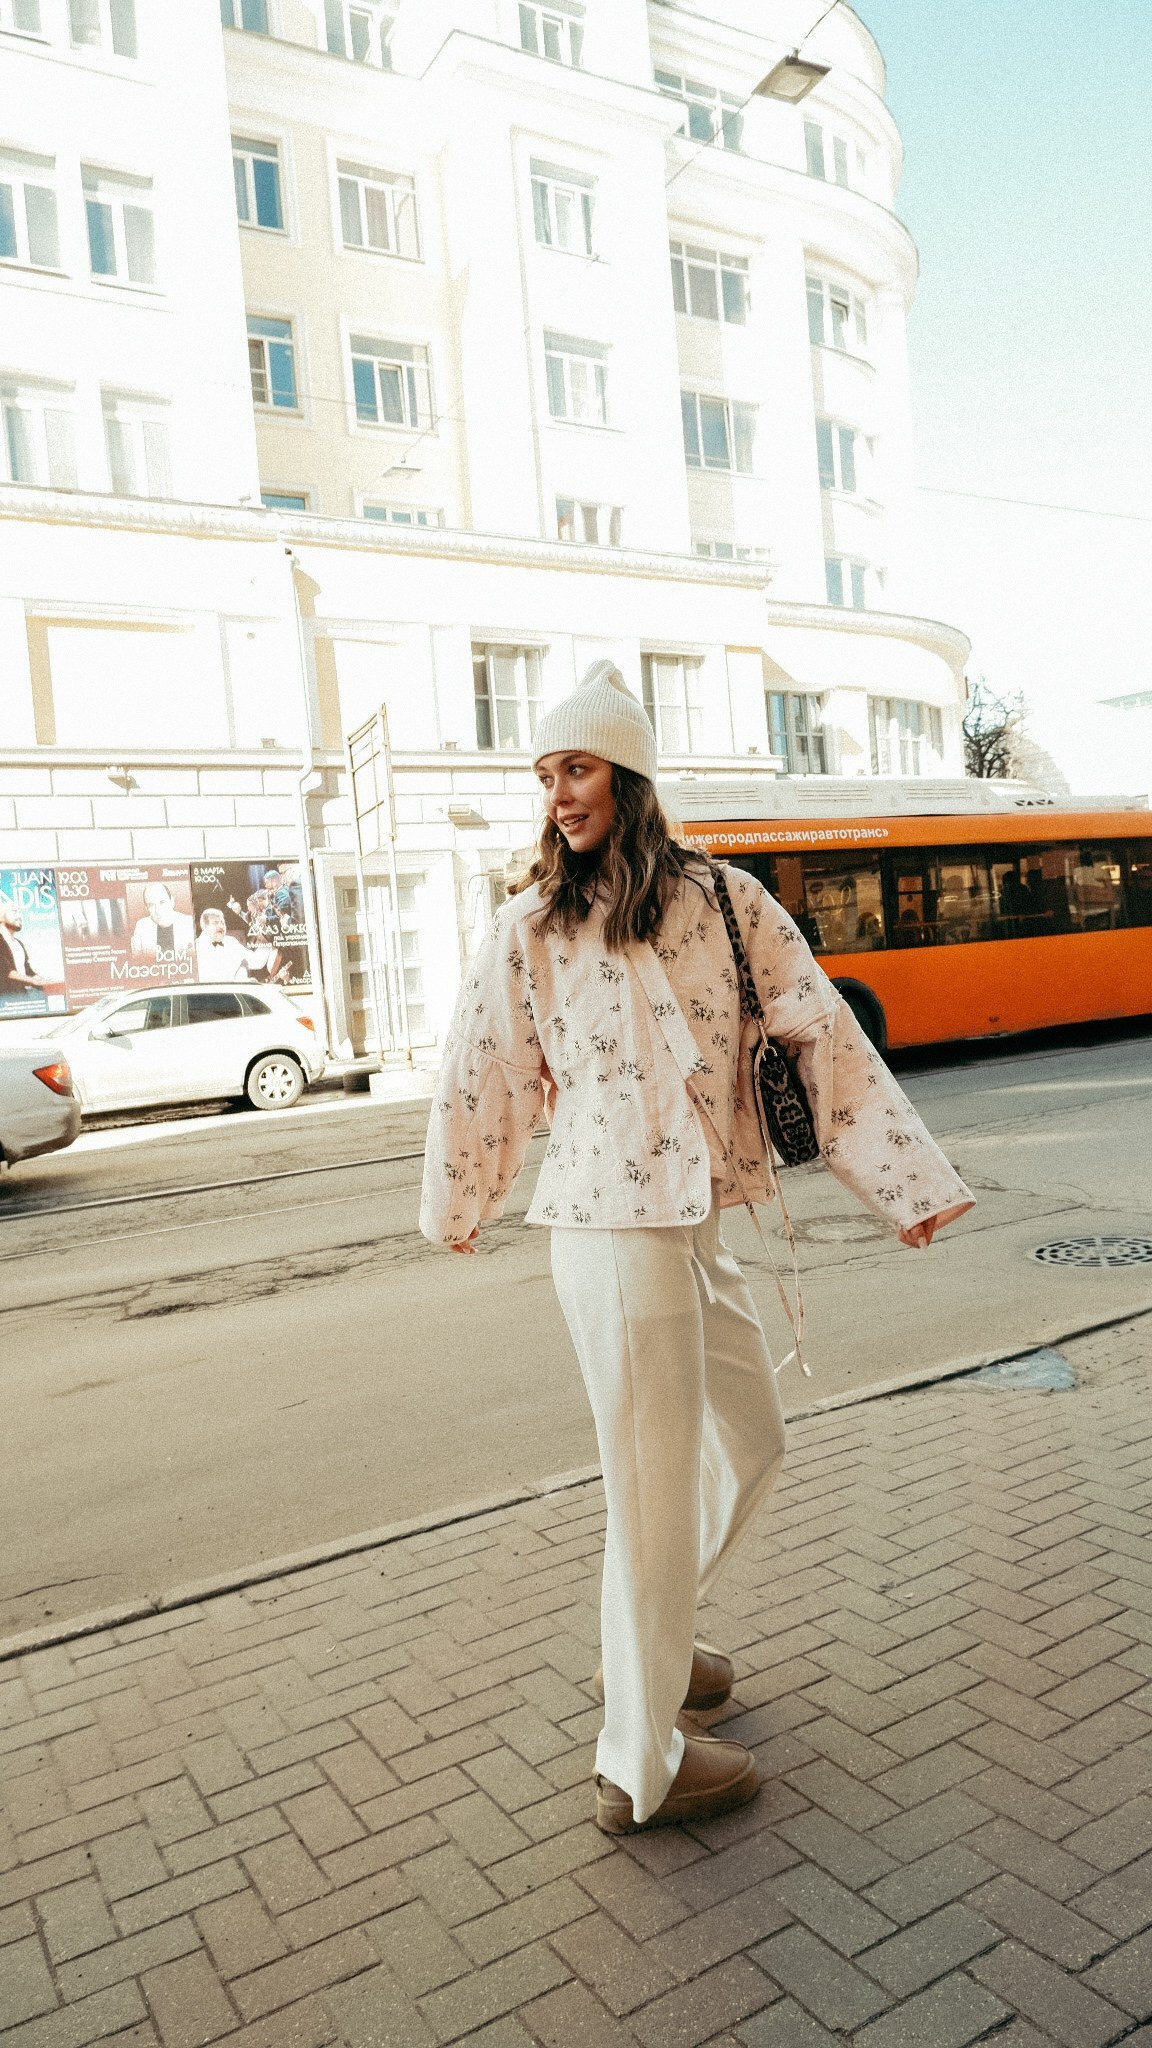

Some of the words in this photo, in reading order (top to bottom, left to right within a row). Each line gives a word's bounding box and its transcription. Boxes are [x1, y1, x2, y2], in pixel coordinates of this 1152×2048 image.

[193, 867, 199, 876] 8
[200, 866, 225, 875] МАРТА
[10, 870, 53, 887] JUAN
[247, 924, 279, 937] ДЖАЗ
